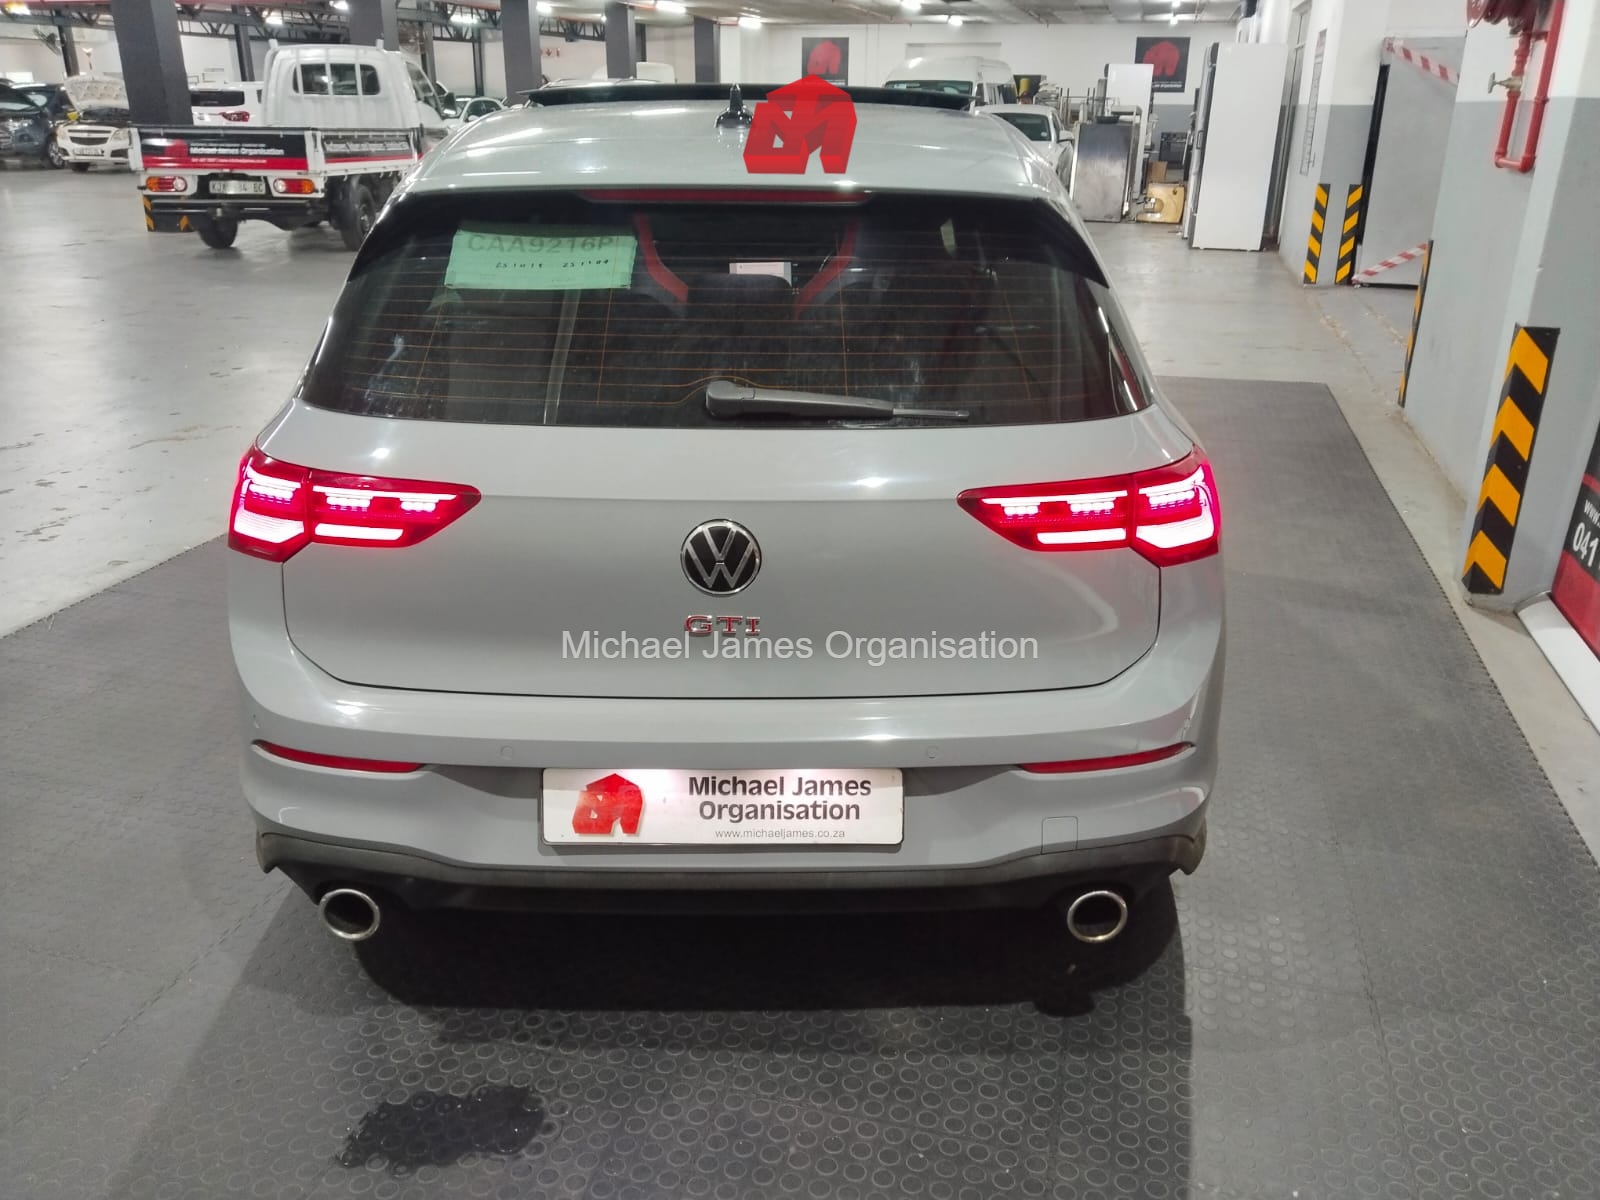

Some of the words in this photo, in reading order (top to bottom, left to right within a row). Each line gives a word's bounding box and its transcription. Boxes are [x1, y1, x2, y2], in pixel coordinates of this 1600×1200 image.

[1573, 522, 1599, 567] 041
[684, 615, 762, 635] GTI
[688, 776, 785, 797] Michael
[792, 776, 872, 797] James
[698, 801, 861, 824] Organisation
[715, 828, 846, 840] www.michaeljames.co.za
